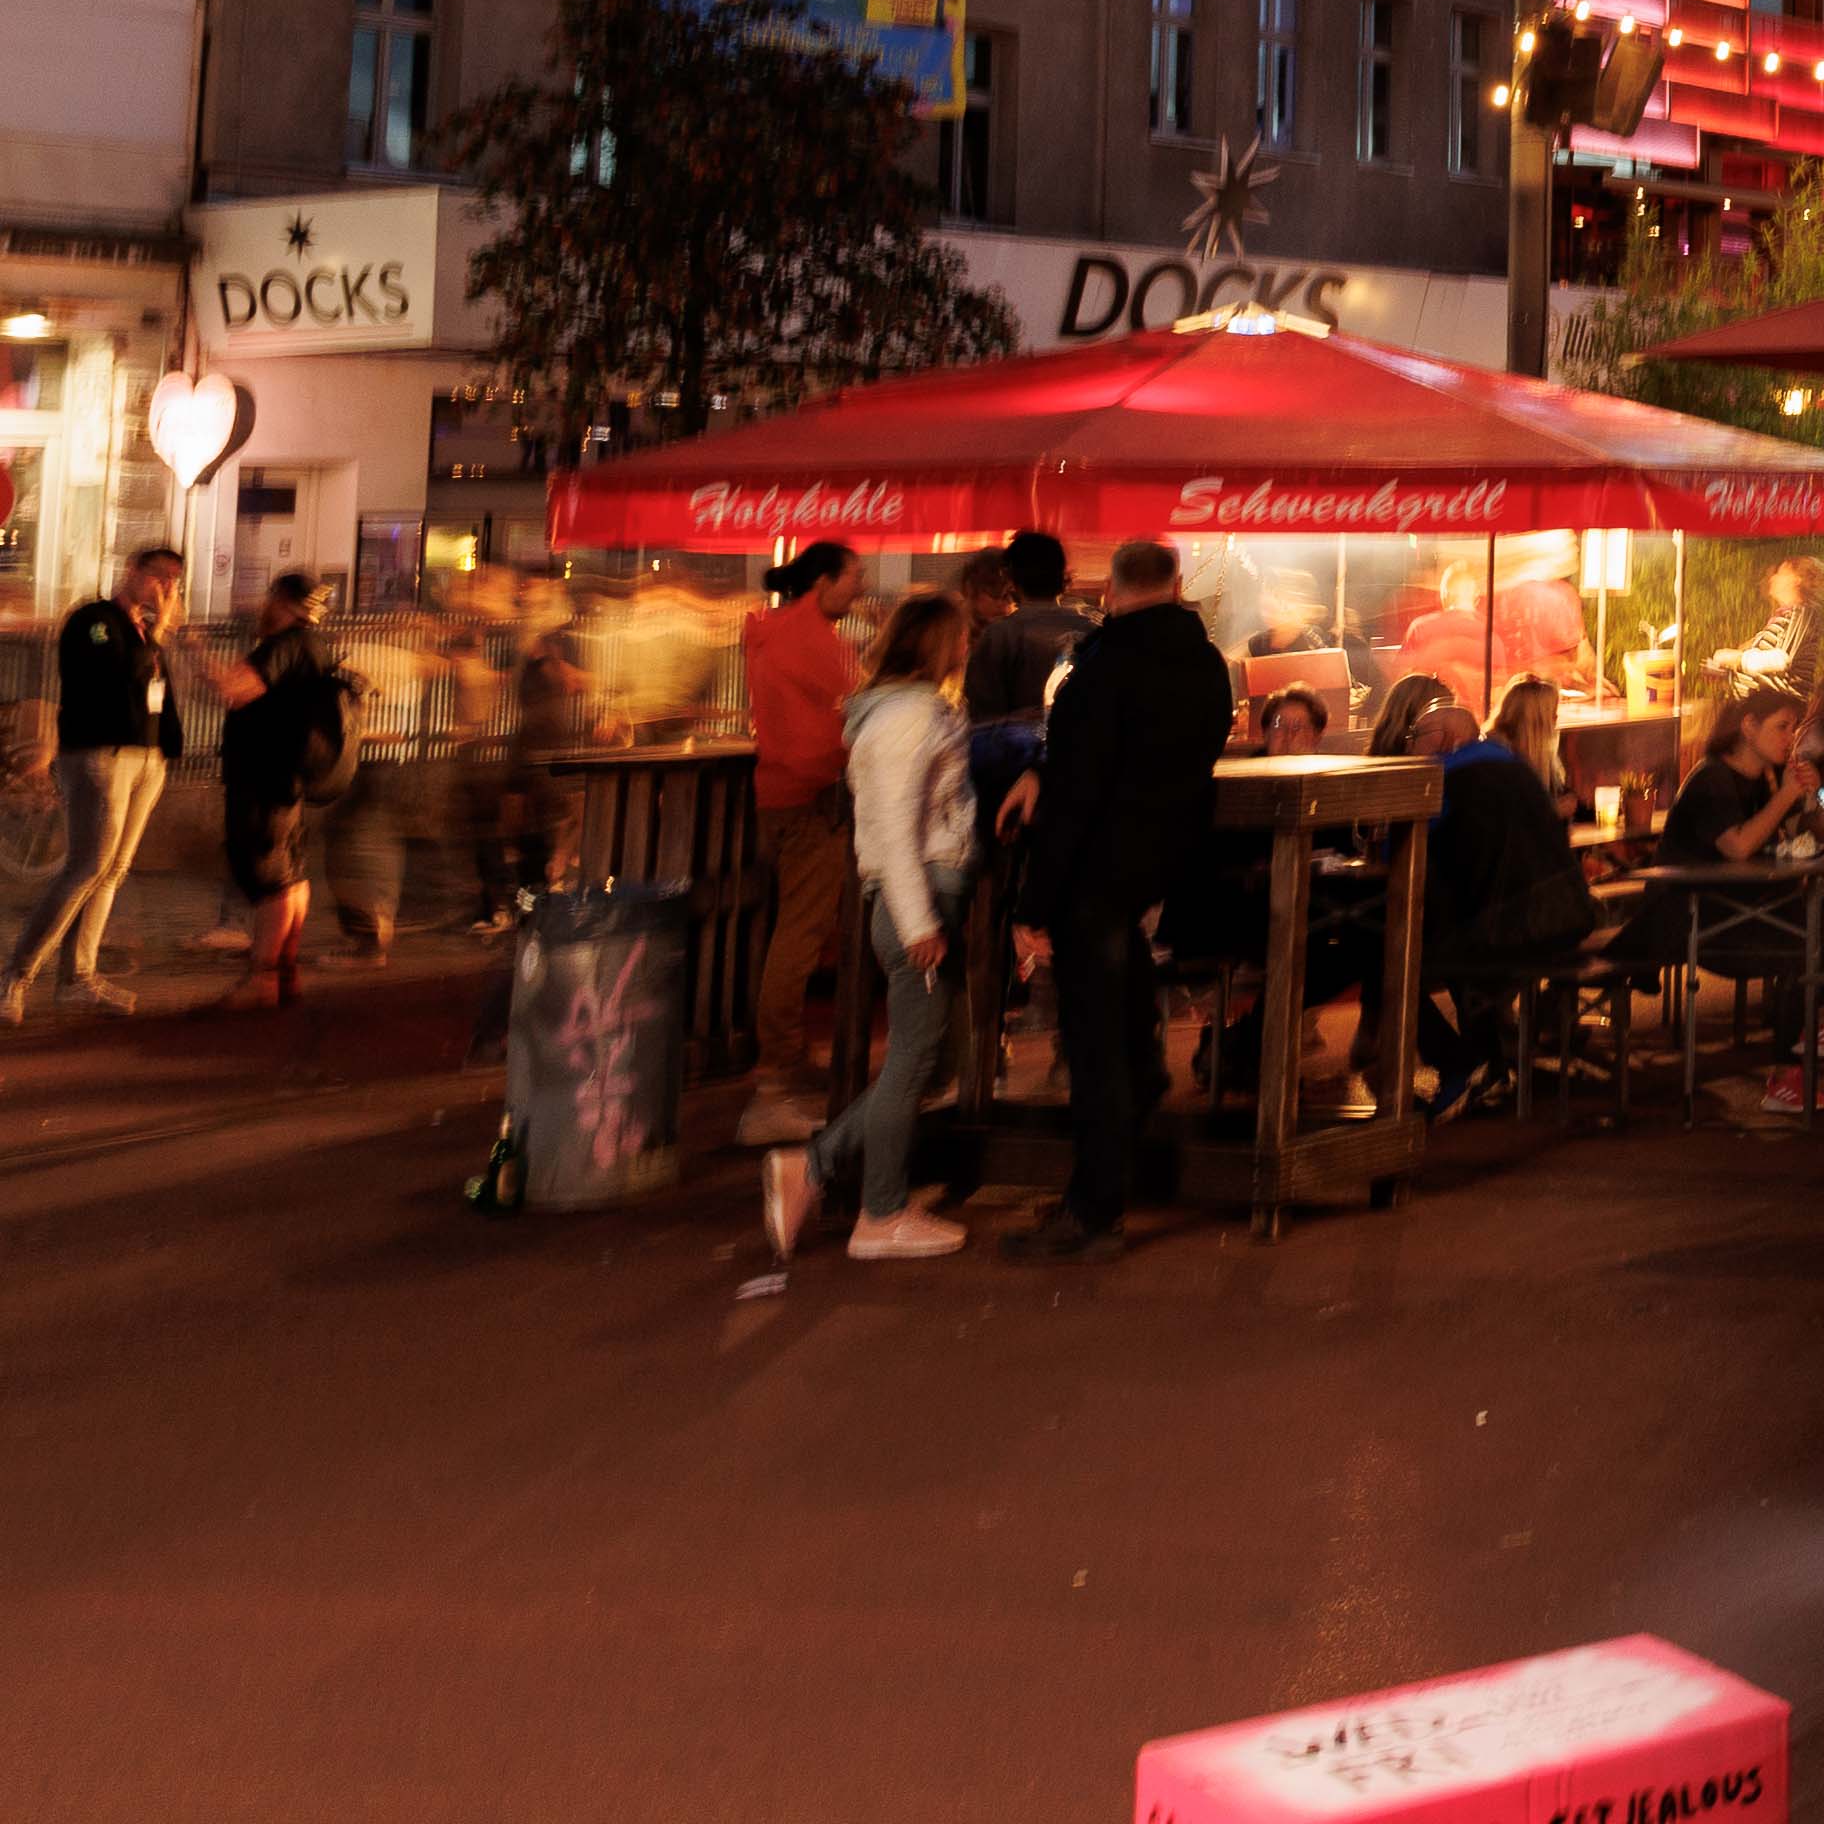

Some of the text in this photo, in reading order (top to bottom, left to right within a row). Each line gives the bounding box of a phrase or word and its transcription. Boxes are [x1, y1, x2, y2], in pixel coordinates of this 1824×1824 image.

[218, 260, 409, 331] DOCKS
[688, 480, 904, 537] Holzkohle
[1168, 476, 1507, 534] Schwenkgrill
[1705, 477, 1823, 528] Holzkohle
[1627, 1765, 1764, 1824] JEALOUS
